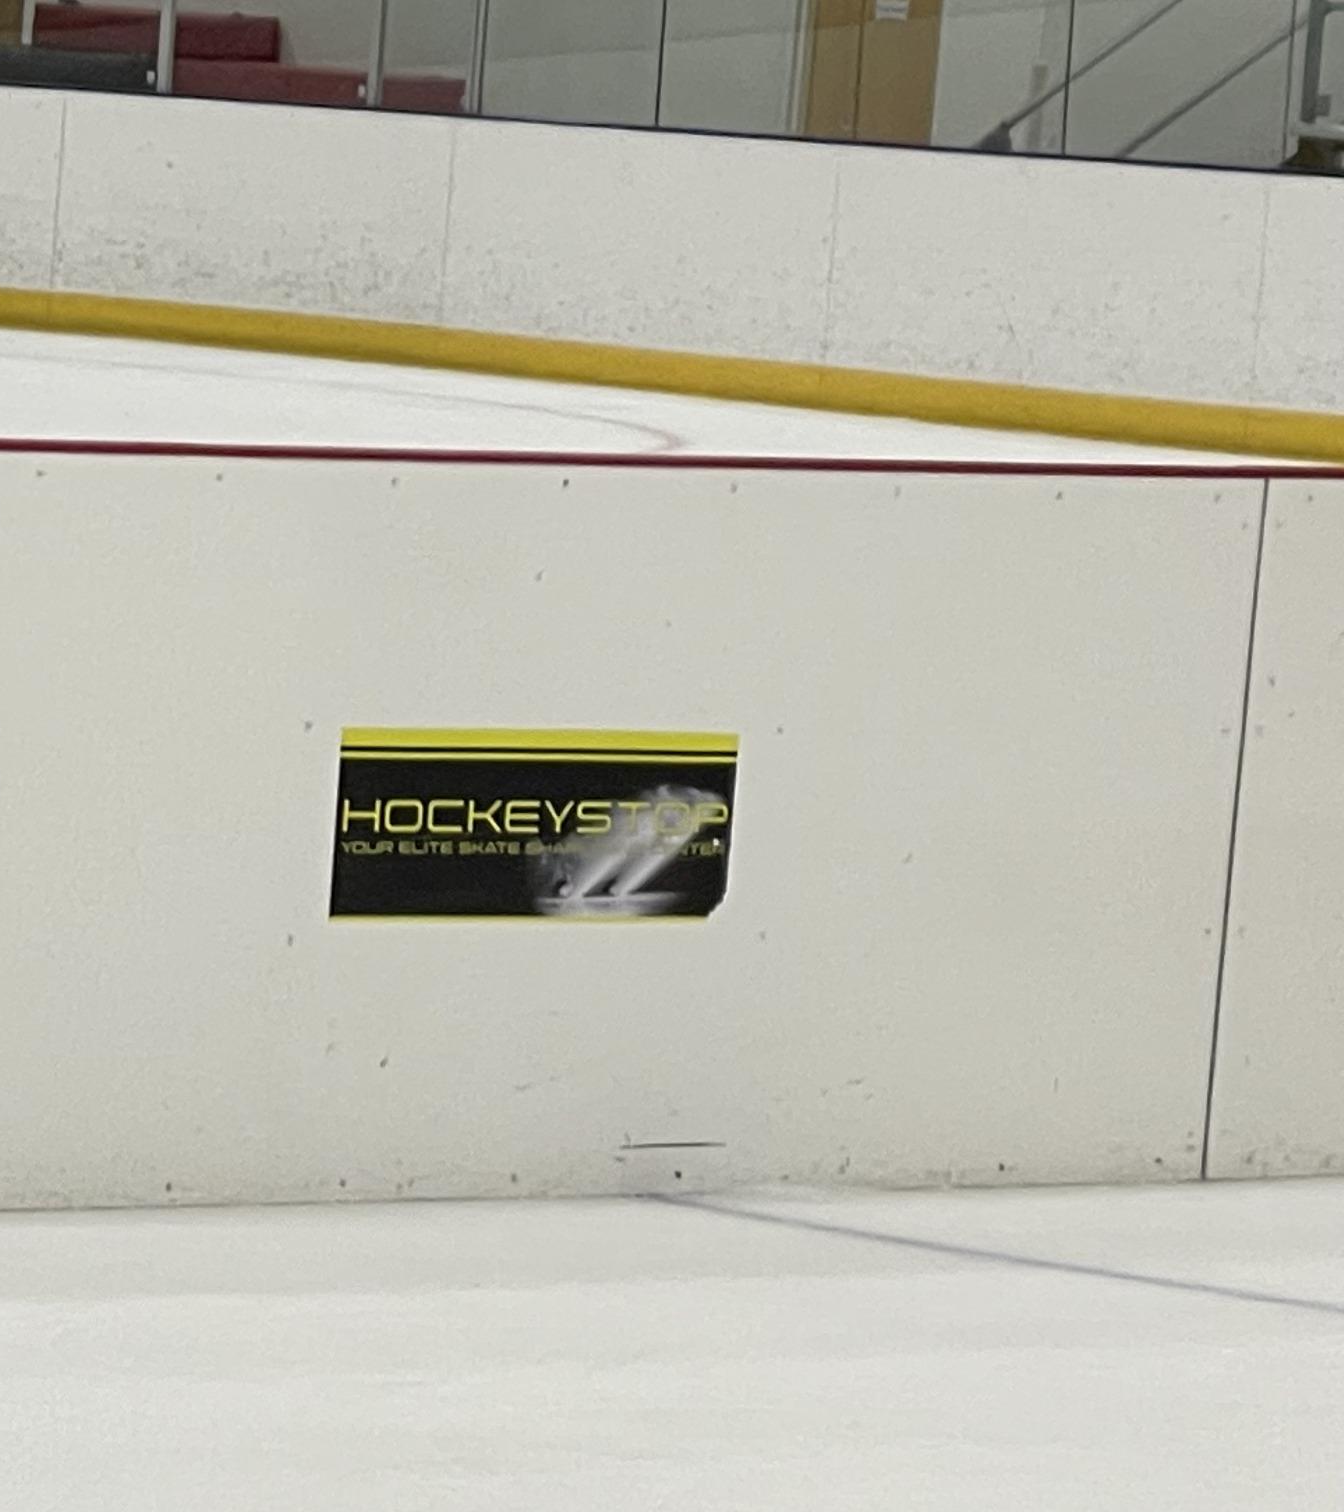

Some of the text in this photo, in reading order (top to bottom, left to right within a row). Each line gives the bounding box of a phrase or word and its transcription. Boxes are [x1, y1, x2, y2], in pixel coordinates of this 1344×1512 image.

[342, 798, 729, 834] HOCKEYSTOP
[340, 841, 394, 855] YOUR
[400, 841, 453, 855] ELITE
